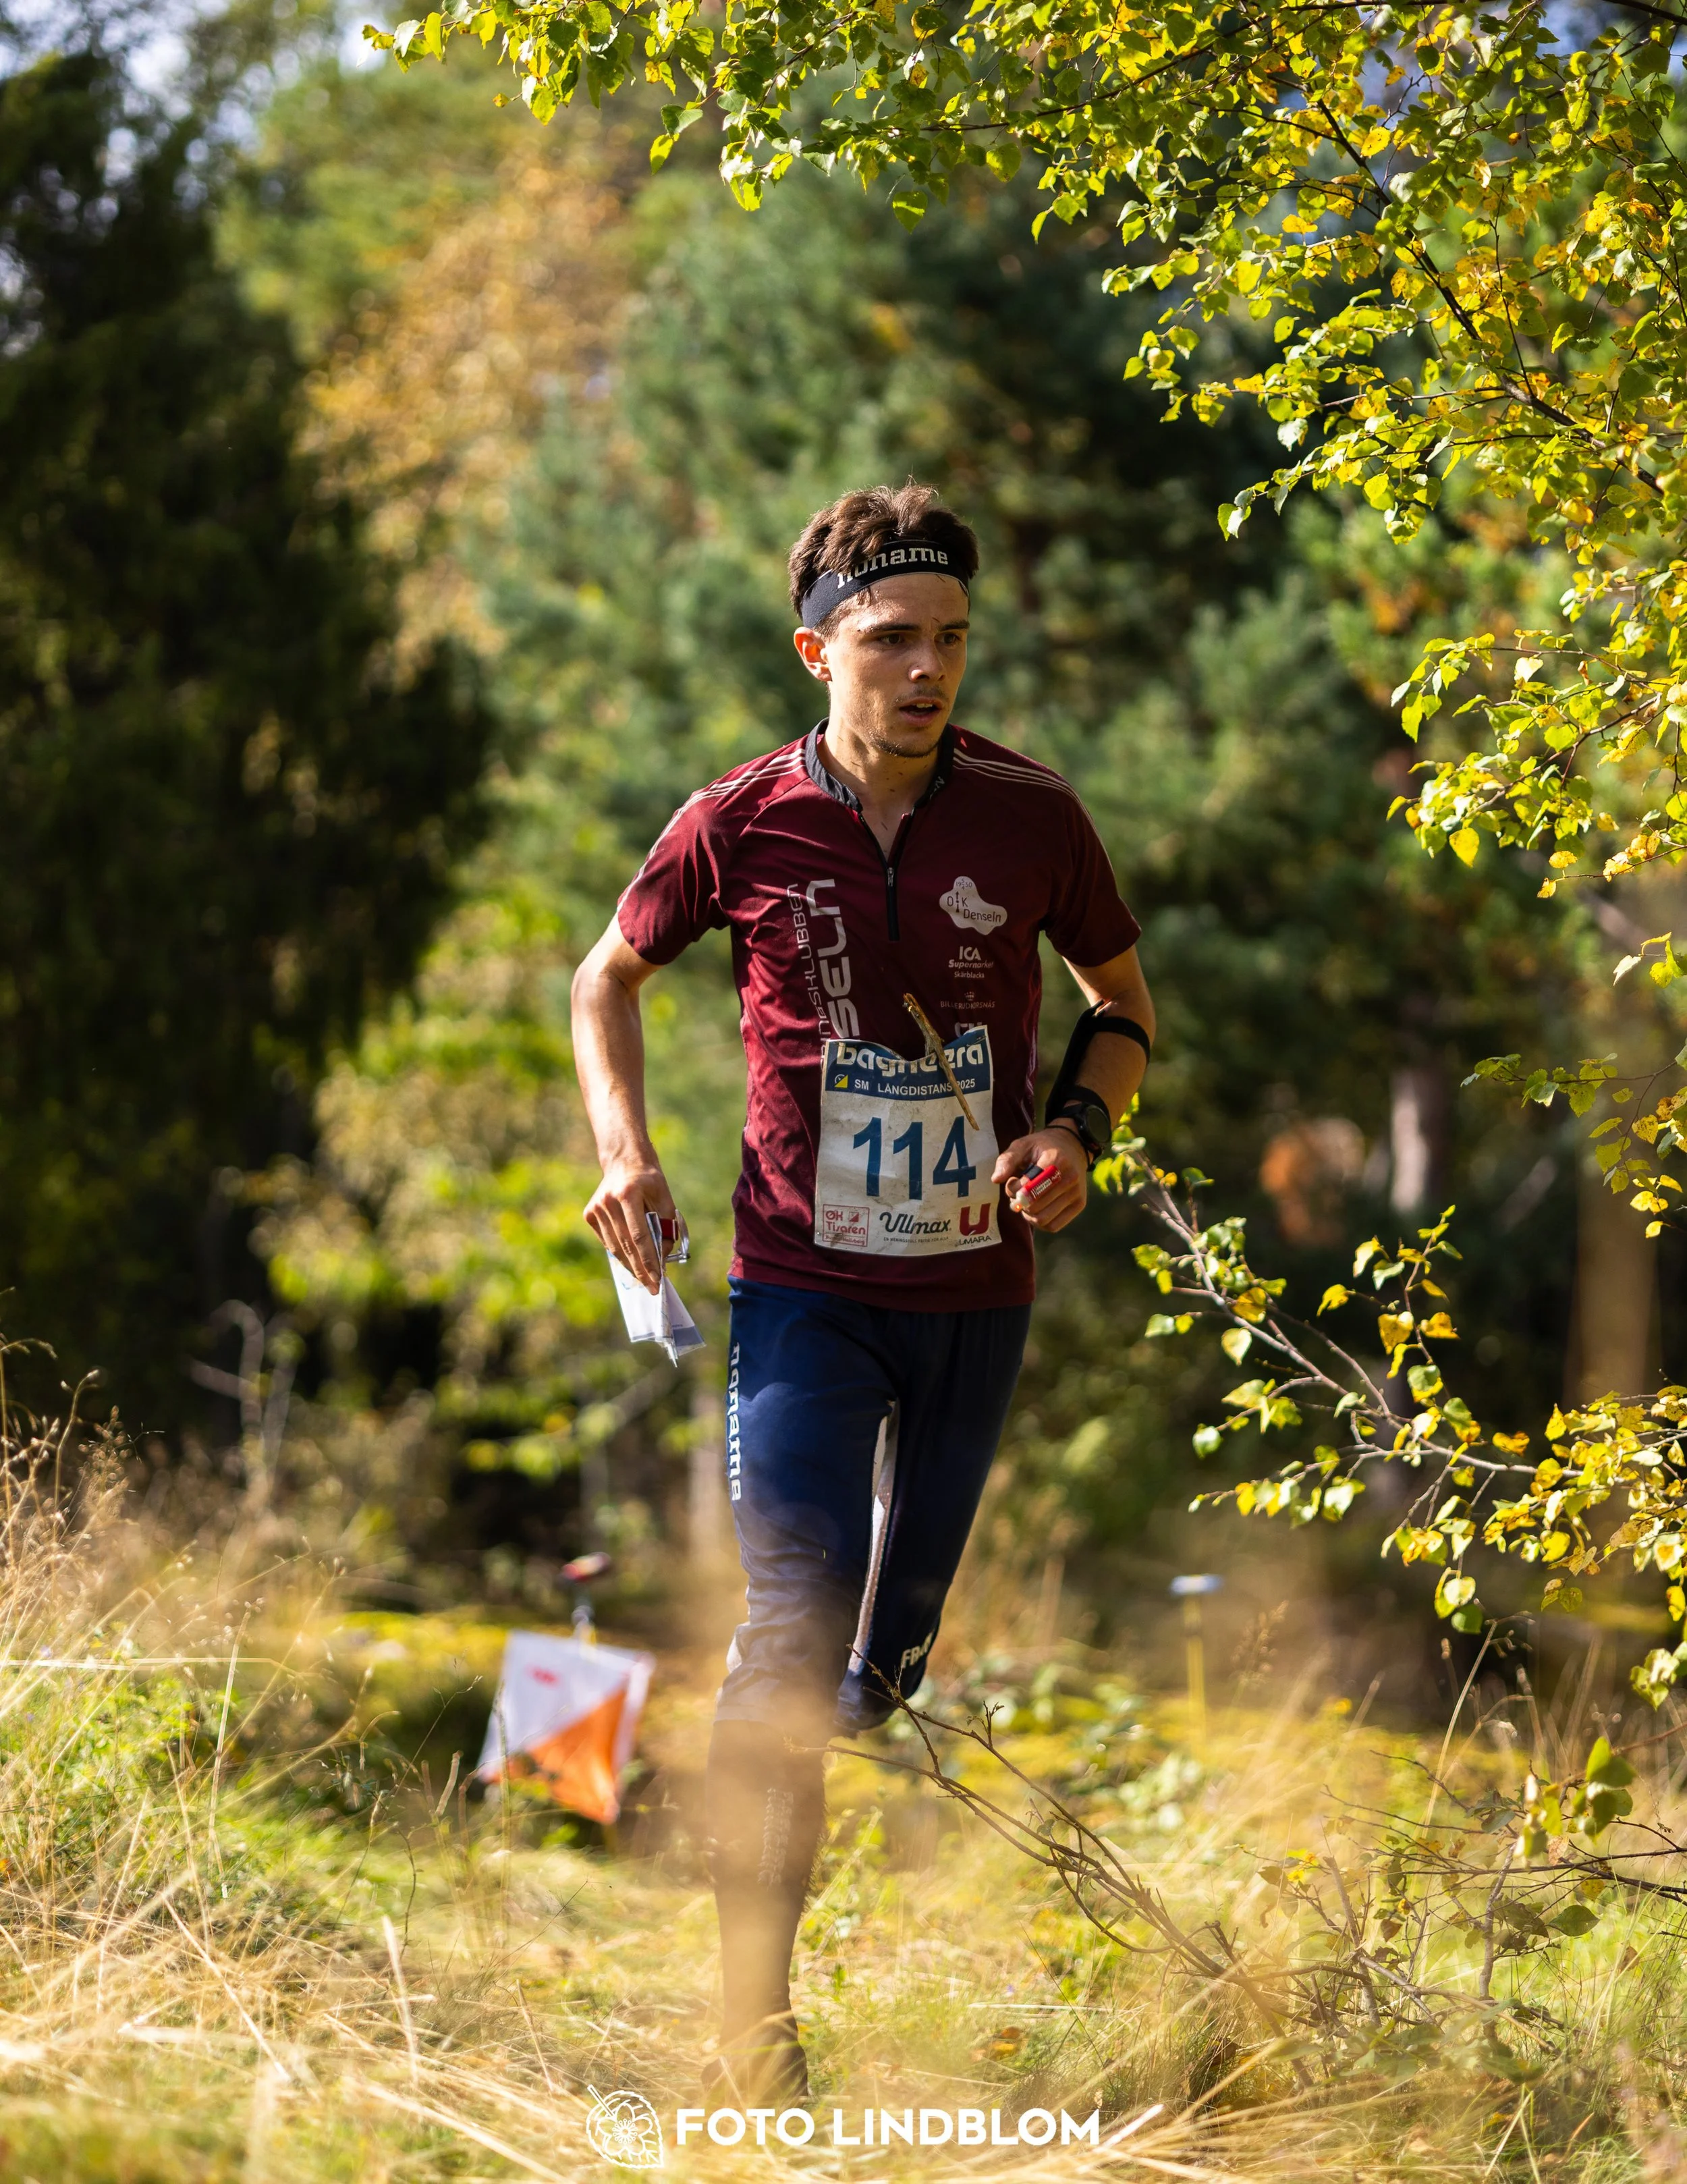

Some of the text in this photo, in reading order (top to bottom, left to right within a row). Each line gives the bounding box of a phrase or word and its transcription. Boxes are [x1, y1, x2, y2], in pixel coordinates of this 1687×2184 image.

[964, 908, 1001, 923] Denseln
[959, 946, 981, 961] ICA
[948, 959, 994, 969] Supermarket
[954, 971, 985, 979] Skärblacka
[854, 1079, 869, 1091] SM
[878, 1082, 953, 1095] LÅNGDISTANS
[853, 1116, 976, 1201] 114
[825, 1221, 866, 1234] Tisaren
[879, 1212, 951, 1234] Ullmax
[959, 1236, 992, 1245] UMARA
[727, 1342, 741, 1501] noname
